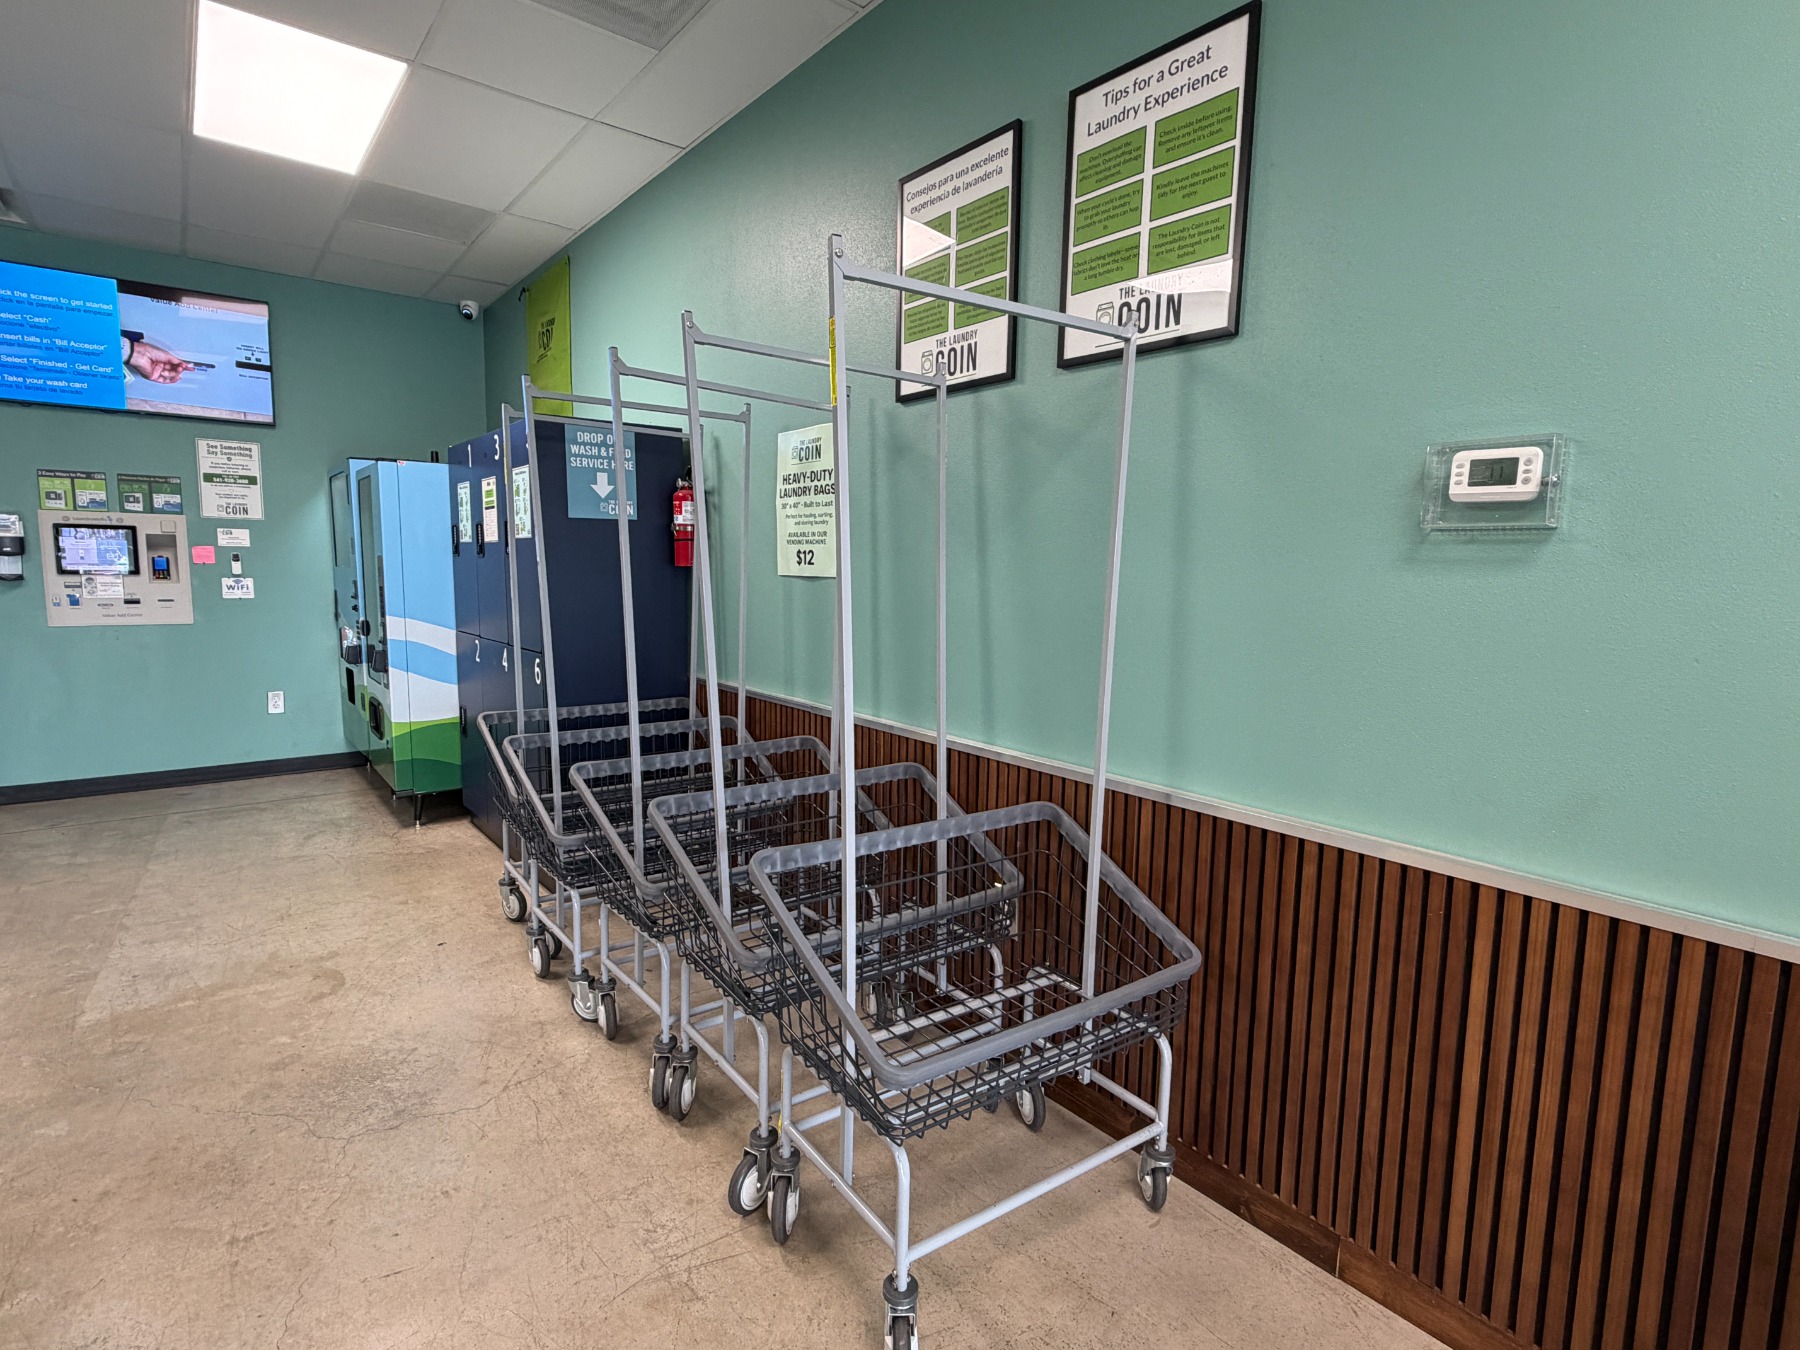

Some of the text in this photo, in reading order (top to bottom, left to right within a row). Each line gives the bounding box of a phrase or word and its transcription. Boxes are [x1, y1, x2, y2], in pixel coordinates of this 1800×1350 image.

[1103, 44, 1212, 108] Tips for a Great
[1087, 65, 1228, 138] Laundry Experience
[1158, 114, 1233, 147] Remove any leftover items
[1160, 127, 1176, 138] Check
[1178, 121, 1194, 132] inside
[1196, 112, 1215, 124] before
[1165, 144, 1176, 154] and
[1176, 138, 1196, 149] ensure
[906, 147, 1009, 203] Consejos para una excelente
[1156, 180, 1174, 190] Kindly
[1175, 175, 1190, 184] leave
[1200, 162, 1228, 176] machines
[910, 190, 950, 215] experiencia
[951, 184, 960, 196] de
[962, 164, 1003, 192] lavandería
[1158, 191, 1168, 199] tidy
[1178, 184, 1188, 192] the
[1188, 180, 1202, 188] next
[1202, 174, 1218, 185] guest
[1077, 207, 1090, 216] When
[1090, 211, 1100, 220] grab
[1112, 200, 1131, 210] laundry
[1104, 212, 1120, 222] others
[1152, 224, 1226, 250] responsibility for items that
[1158, 232, 1168, 240] The
[1168, 226, 1190, 237] Laundry
[1190, 222, 1204, 230] Coin
[1210, 216, 1220, 224] not
[1120, 254, 1132, 262] heat
[14, 290, 28, 298] the
[30, 294, 58, 302] screen
[60, 296, 68, 304] to
[85, 301, 112, 310] started
[1119, 286, 1136, 300] THE
[936, 328, 978, 348] THE LAUNDRY
[0, 354, 28, 364] Select
[30, 358, 68, 368] "Finished
[75, 363, 90, 371] Get
[2, 374, 24, 383] Take
[46, 379, 68, 387] wash
[494, 434, 500, 460] 3
[577, 432, 604, 444] DROP
[206, 442, 252, 453] See Something
[206, 448, 252, 459] Say Something
[467, 444, 472, 468] 1
[570, 444, 632, 458] WASH & FD
[798, 444, 822, 462] COIN
[570, 457, 634, 470] SERVICE HRE
[782, 468, 834, 486] HEAVY-DUTY
[780, 483, 836, 499] LAUNDRY BAGS
[225, 506, 248, 516] COIN
[804, 500, 814, 508] Built
[786, 538, 804, 546] VENDING
[810, 530, 816, 538] IN
[816, 530, 828, 538] OUR
[796, 548, 814, 566] $12
[474, 640, 480, 662] 2
[502, 648, 508, 672] 4
[534, 658, 542, 685] 6
